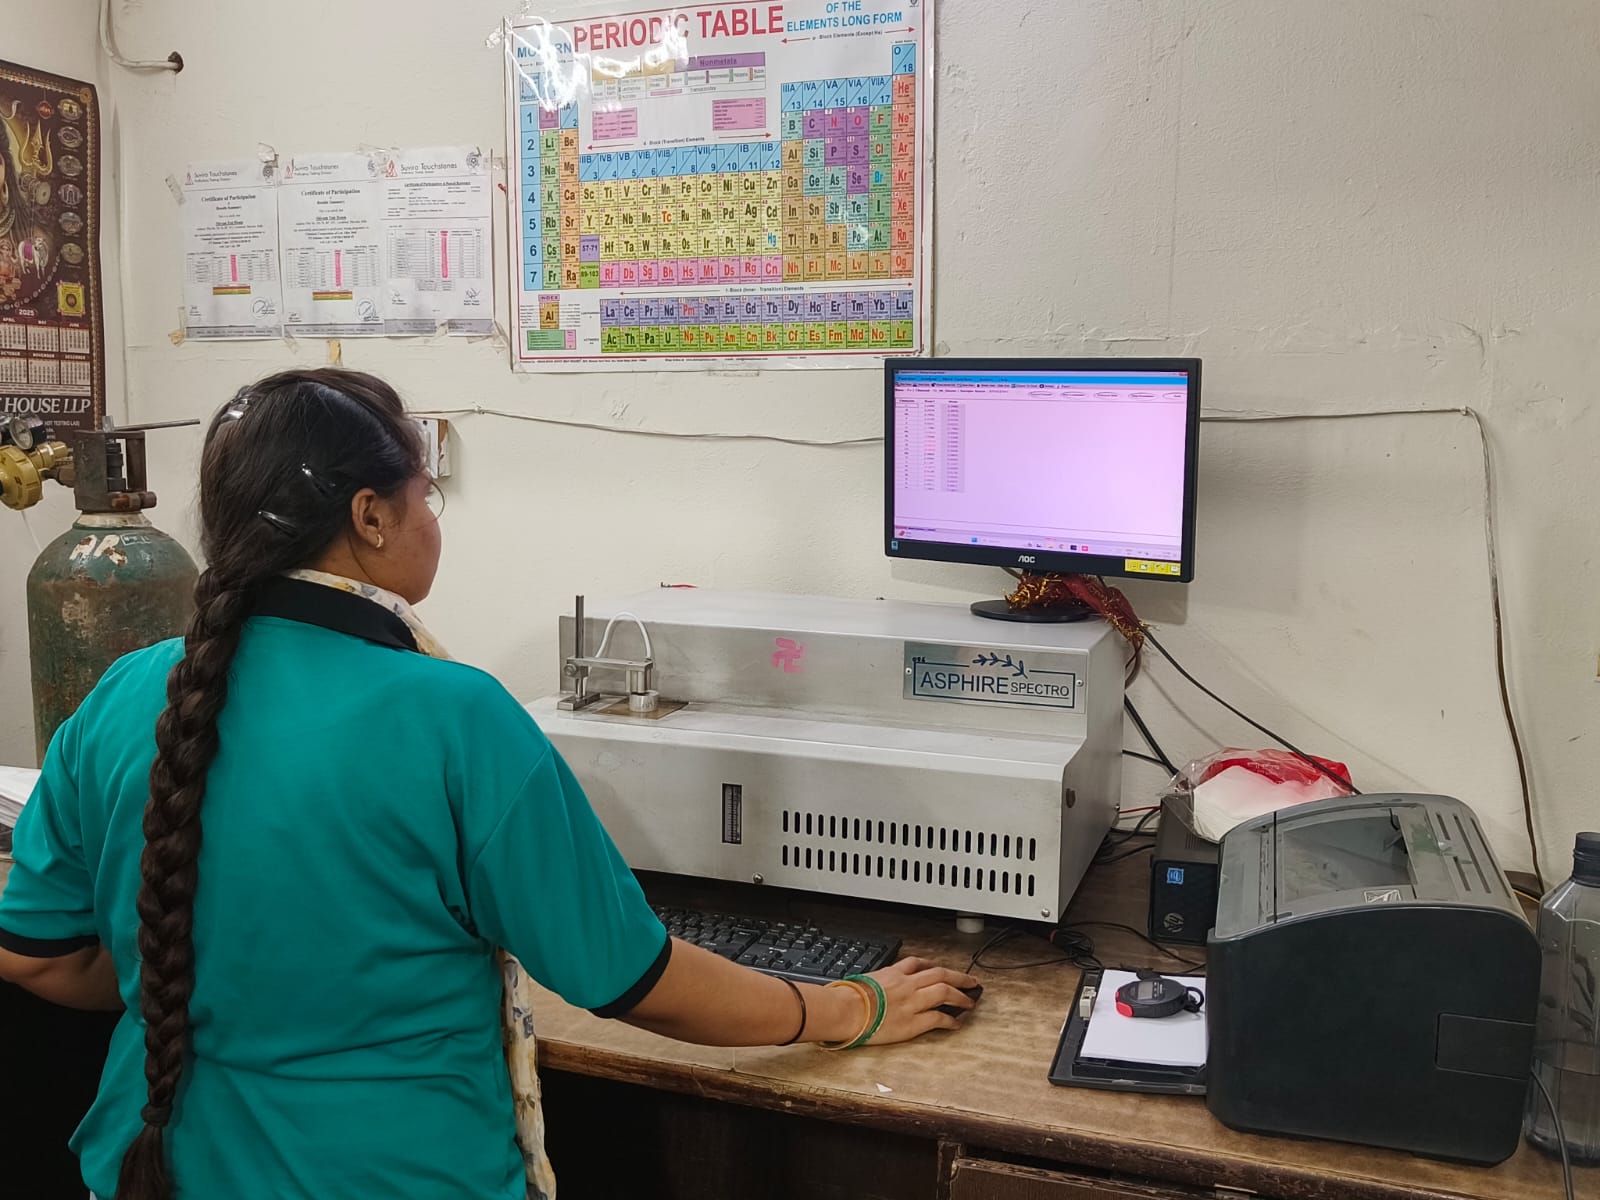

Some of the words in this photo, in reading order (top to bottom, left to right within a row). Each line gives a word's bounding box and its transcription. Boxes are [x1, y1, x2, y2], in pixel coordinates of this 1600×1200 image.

[826, 3, 839, 13] OF
[842, 1, 862, 12] THE
[697, 5, 784, 38] TABLE
[787, 17, 839, 32] ELEMENTS
[842, 15, 871, 27] LONG
[873, 12, 902, 24] FORM
[894, 47, 901, 55] O
[903, 64, 913, 72] 18
[804, 82, 816, 91] IVA
[826, 80, 838, 89] VA
[848, 80, 862, 88] VIA
[871, 78, 884, 86] VIIA
[783, 84, 796, 92] IIIA
[898, 82, 910, 94] He
[814, 100, 822, 108] 14
[880, 95, 890, 103] 17
[792, 102, 800, 110] 13
[527, 112, 532, 124] 1
[809, 119, 815, 128] C
[878, 114, 884, 124] F
[898, 114, 909, 124] Ne
[790, 120, 796, 130] B
[528, 139, 534, 150] 2
[546, 138, 554, 148] Li
[564, 137, 574, 146] Be
[762, 144, 773, 152] IIB
[810, 148, 818, 158] Si
[832, 146, 837, 156] P
[853, 145, 860, 156] S
[898, 143, 908, 152] Ar
[600, 154, 612, 162] IVB
[620, 152, 630, 160] VB
[638, 151, 650, 159] VIB
[658, 150, 670, 158] VIIB
[788, 149, 798, 160] Al
[580, 156, 592, 164] IIIB
[770, 160, 780, 168] 12
[528, 165, 535, 177] 3
[544, 166, 556, 176] Na
[691, 165, 696, 173] 8
[711, 164, 716, 172] 9
[728, 162, 736, 170] 10
[749, 162, 758, 170] 11
[594, 172, 598, 180] 3
[612, 170, 616, 178] 4
[652, 168, 656, 176] 6
[898, 170, 907, 181] Kr
[744, 178, 755, 190] Cu
[766, 178, 778, 190] Zn
[788, 176, 798, 188] Ga
[809, 175, 820, 186] Ge
[830, 174, 840, 186] As
[642, 184, 652, 196] Cr
[682, 182, 692, 194] Fe
[701, 181, 712, 192] Co
[723, 180, 732, 192] Ni
[548, 190, 554, 202] K
[564, 190, 575, 200] Ca
[584, 189, 594, 200] Sc
[604, 187, 612, 198] Ti
[624, 186, 630, 198] V
[528, 192, 535, 204] 4
[830, 202, 840, 214] Sb
[852, 202, 861, 213] Te
[877, 200, 880, 212] I
[898, 199, 907, 211] Xe
[662, 211, 672, 222] Tc
[723, 208, 734, 220] Pd
[745, 204, 757, 218] Ag
[766, 206, 778, 218] Cd
[529, 218, 536, 230] 5
[546, 217, 556, 228] Rb
[566, 216, 574, 228] Sr
[586, 215, 592, 226] Y
[604, 214, 614, 226] Zr
[604, 242, 614, 253] Hf
[624, 241, 634, 252] Ta
[642, 240, 650, 252] W
[726, 236, 734, 248] Pt
[746, 236, 755, 248] Au
[530, 245, 537, 256] 6
[546, 244, 556, 256] Cs
[565, 244, 576, 255] Ba
[745, 262, 756, 275] Rg
[766, 263, 778, 274] Cn
[875, 260, 884, 270] Ts
[530, 271, 538, 282] 7
[548, 270, 556, 282] Fr
[704, 304, 714, 315] Sm
[725, 303, 735, 314] Eu
[746, 302, 756, 314] Gd
[766, 302, 778, 314] Tb
[788, 300, 800, 314] Dy
[810, 302, 822, 312] Ho
[831, 301, 840, 312] Er
[851, 300, 864, 311] Tm
[874, 300, 885, 310] Yb
[896, 299, 908, 310] Lu
[605, 306, 615, 318] La
[624, 306, 634, 316] Ce
[644, 305, 654, 316] Pr
[664, 305, 674, 316] Nd
[606, 334, 616, 344] Ac
[664, 332, 671, 344] U
[788, 330, 798, 341] Cf
[810, 330, 820, 340] Es
[828, 330, 842, 340] Fm
[850, 329, 864, 340] Md
[872, 328, 884, 340] No
[896, 328, 906, 339] Lr
[4, 397, 60, 414] HOUSE
[64, 398, 91, 414] LLP
[1018, 554, 1036, 564] AOC
[920, 671, 1009, 694] ASPHIRE
[1010, 682, 1070, 696] SPECTRO
